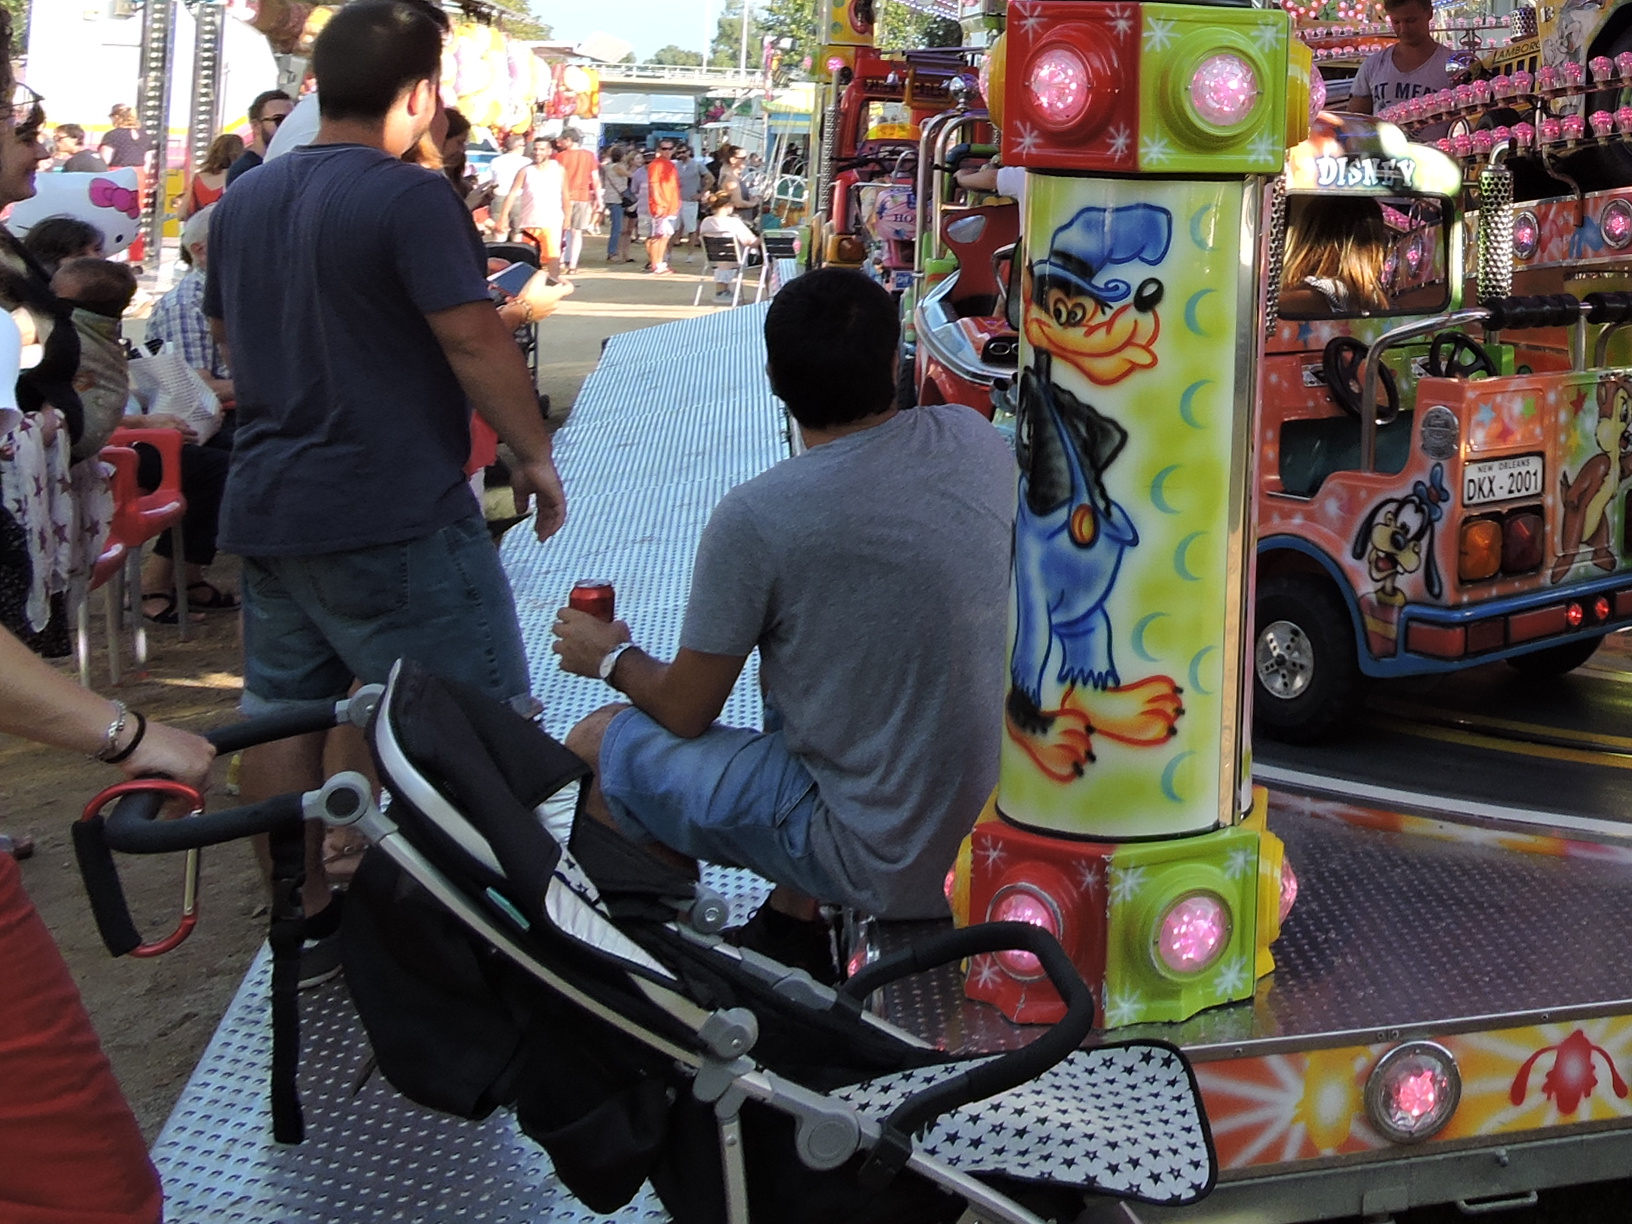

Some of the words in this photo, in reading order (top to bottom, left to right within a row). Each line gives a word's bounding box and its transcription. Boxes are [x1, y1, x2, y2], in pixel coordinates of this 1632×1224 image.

[1395, 82, 1438, 99] MEA
[1315, 156, 1416, 187] DISNEY
[1478, 466, 1494, 474] NEW
[1499, 459, 1531, 471] ORLEANS
